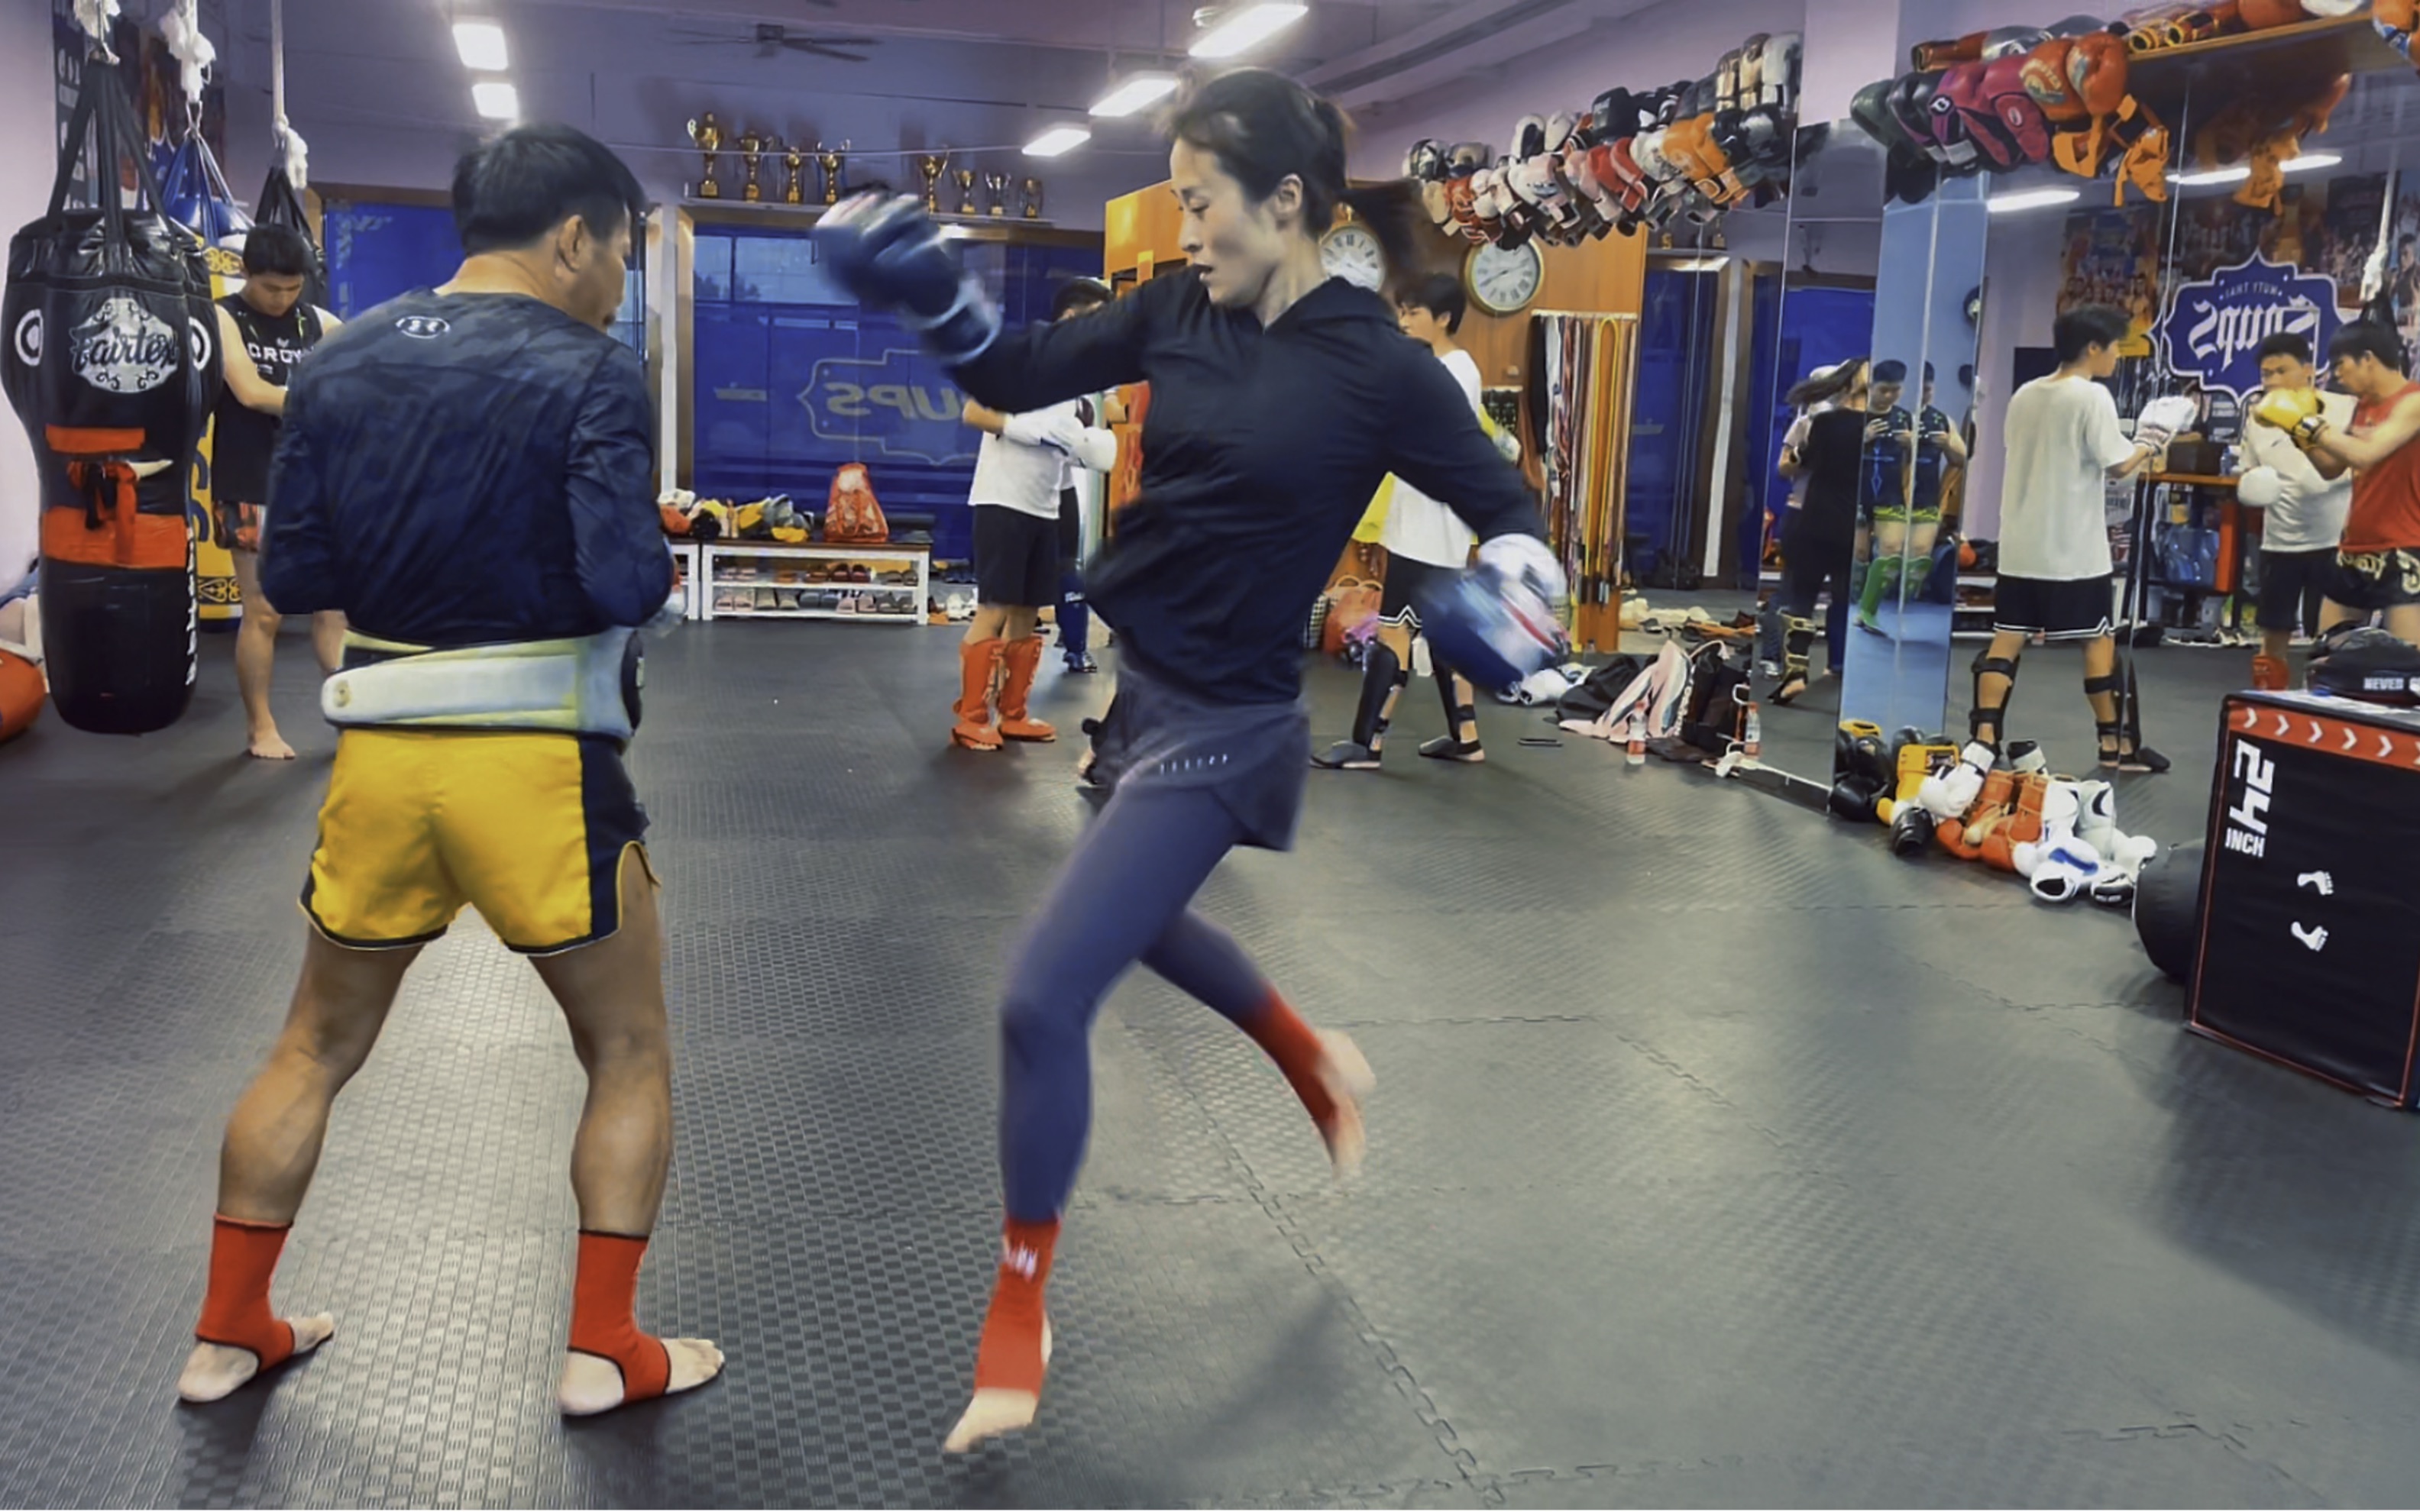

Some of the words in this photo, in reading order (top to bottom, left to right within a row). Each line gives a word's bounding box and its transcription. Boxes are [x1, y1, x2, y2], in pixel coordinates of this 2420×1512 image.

[70, 321, 179, 374] Fairtex
[2229, 738, 2275, 835] 24
[2224, 827, 2266, 858] INCH
